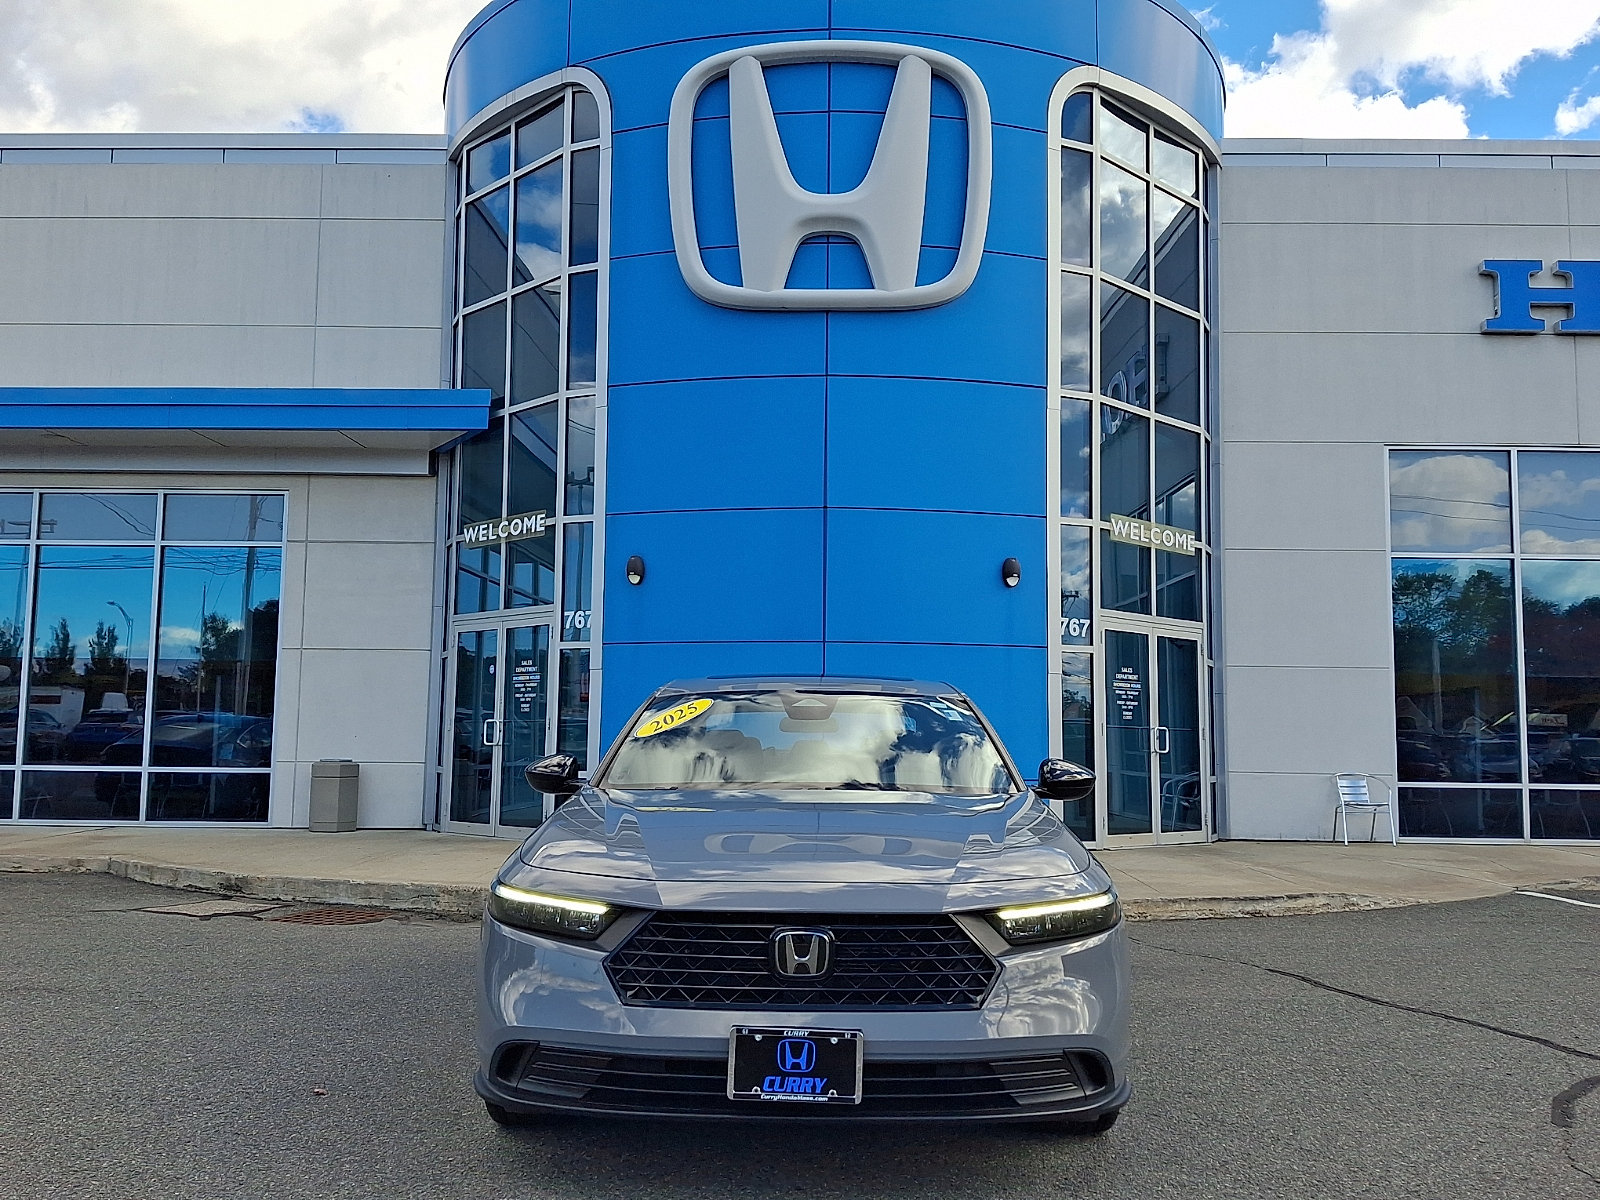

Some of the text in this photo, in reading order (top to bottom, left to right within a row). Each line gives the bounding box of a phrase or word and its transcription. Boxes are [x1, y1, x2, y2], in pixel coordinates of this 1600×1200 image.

[463, 513, 546, 544] WELCOME
[1110, 518, 1196, 551] WELCOME
[564, 610, 592, 630] 767
[1060, 617, 1091, 638] 767
[650, 702, 698, 732] 2025
[762, 1075, 828, 1093] CURRY
